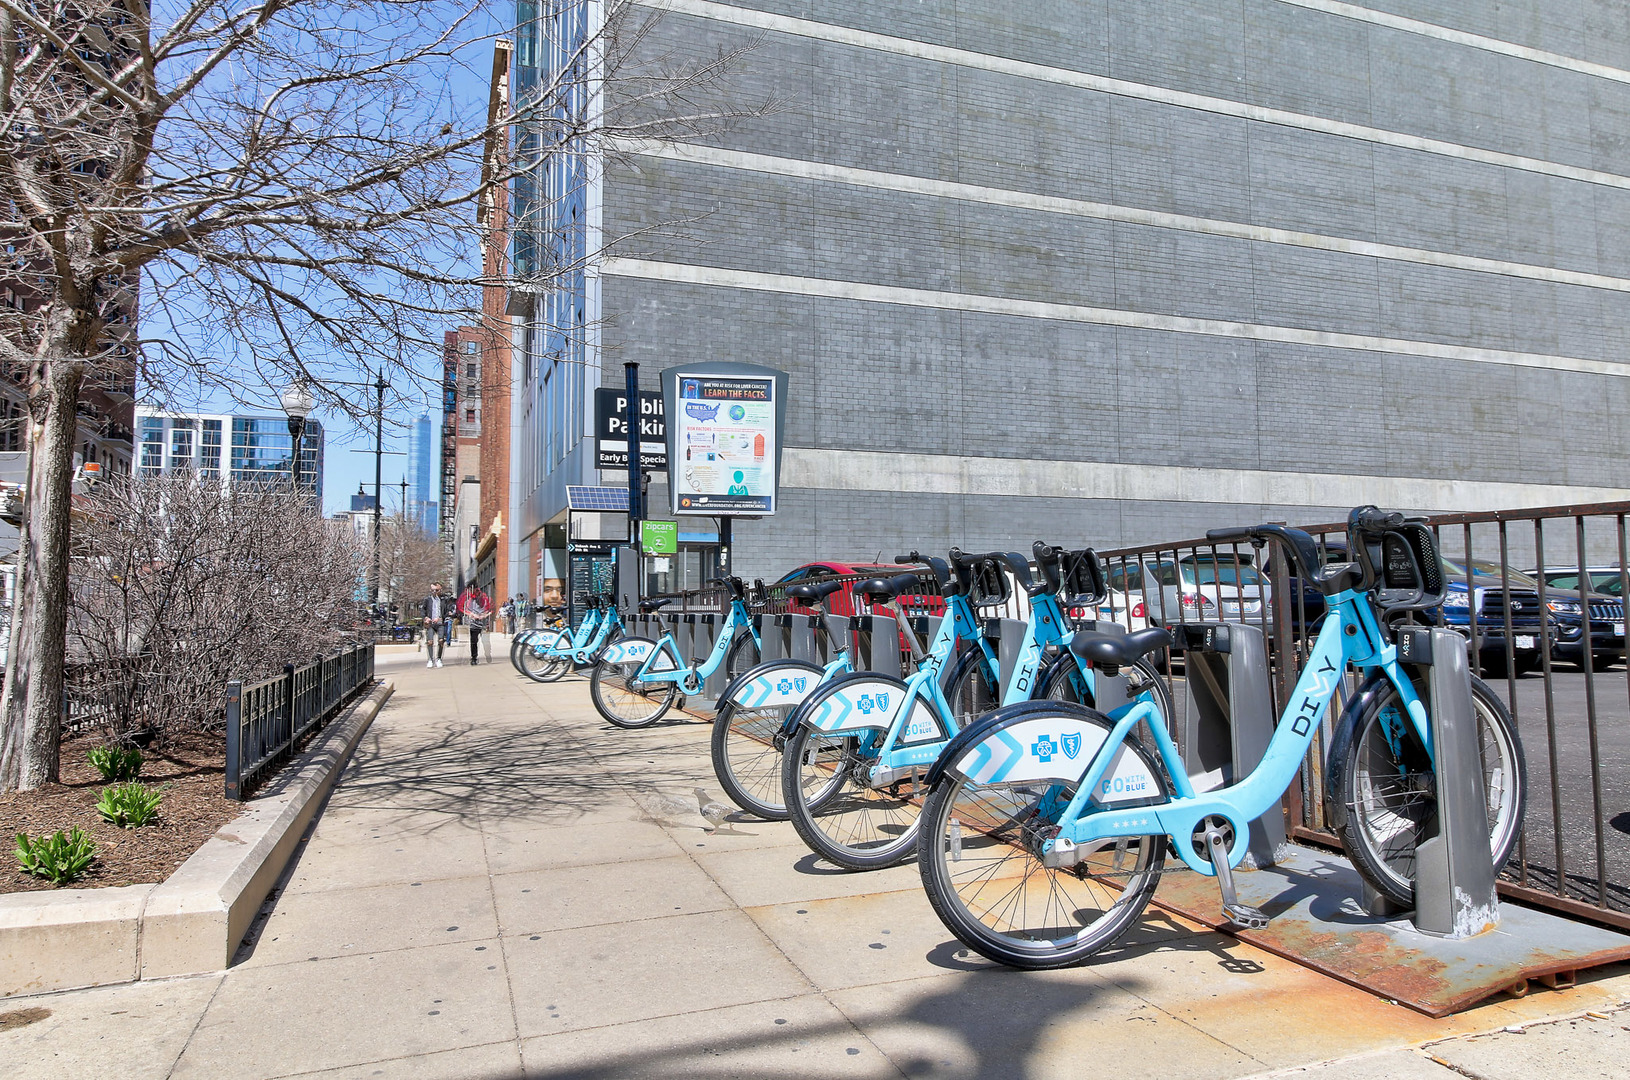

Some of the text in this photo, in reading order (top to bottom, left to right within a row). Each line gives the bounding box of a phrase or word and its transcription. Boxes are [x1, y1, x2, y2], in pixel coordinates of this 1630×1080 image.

[704, 389, 767, 399] LEARN THE FACTS.
[616, 397, 663, 415] Pbli
[609, 417, 664, 435] Paki
[600, 453, 621, 463] Early
[640, 455, 666, 464] Specia
[645, 522, 674, 531] zipcars
[1016, 636, 1041, 692] DIVVY
[1291, 655, 1336, 737] DIVVY
[904, 724, 918, 736] GO
[1101, 777, 1146, 795] GO BLUE
[1125, 774, 1145, 783] WITH
